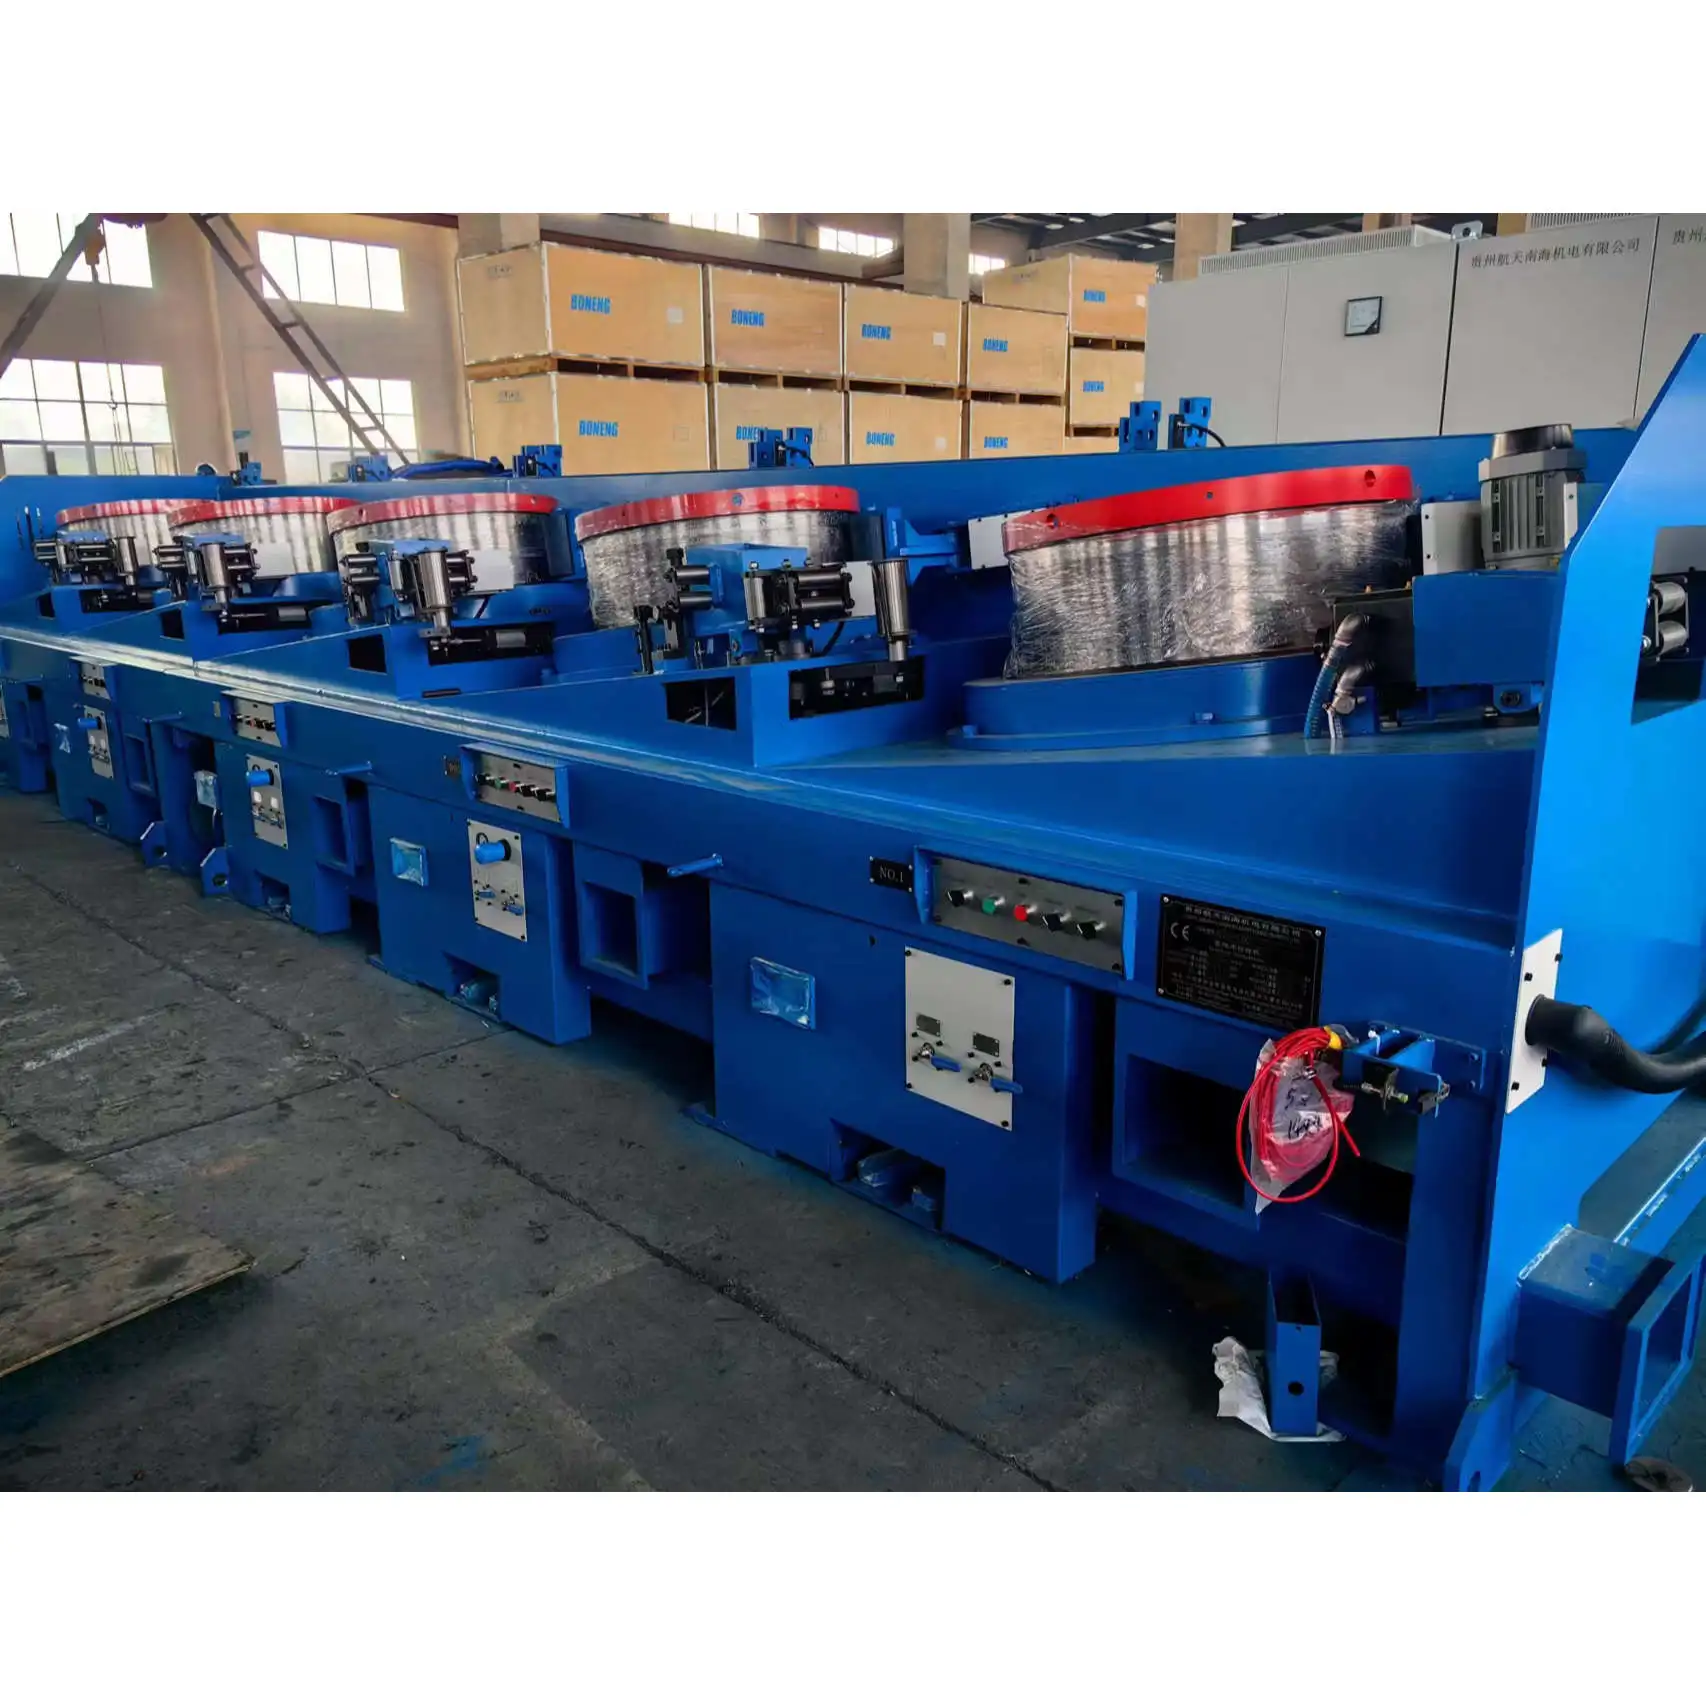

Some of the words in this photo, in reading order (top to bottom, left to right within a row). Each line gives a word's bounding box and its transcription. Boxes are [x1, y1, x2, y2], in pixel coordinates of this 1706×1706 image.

[571, 295, 611, 314] BONENG
[732, 309, 765, 326] BONENG
[862, 324, 891, 340] BONENG
[983, 339, 1008, 352] BONENG
[579, 420, 618, 437] BONENG
[866, 432, 895, 446] BONENG
[984, 437, 1008, 449] BONENG
[880, 865, 904, 883] NO.1
[1170, 922, 1190, 941] CE
